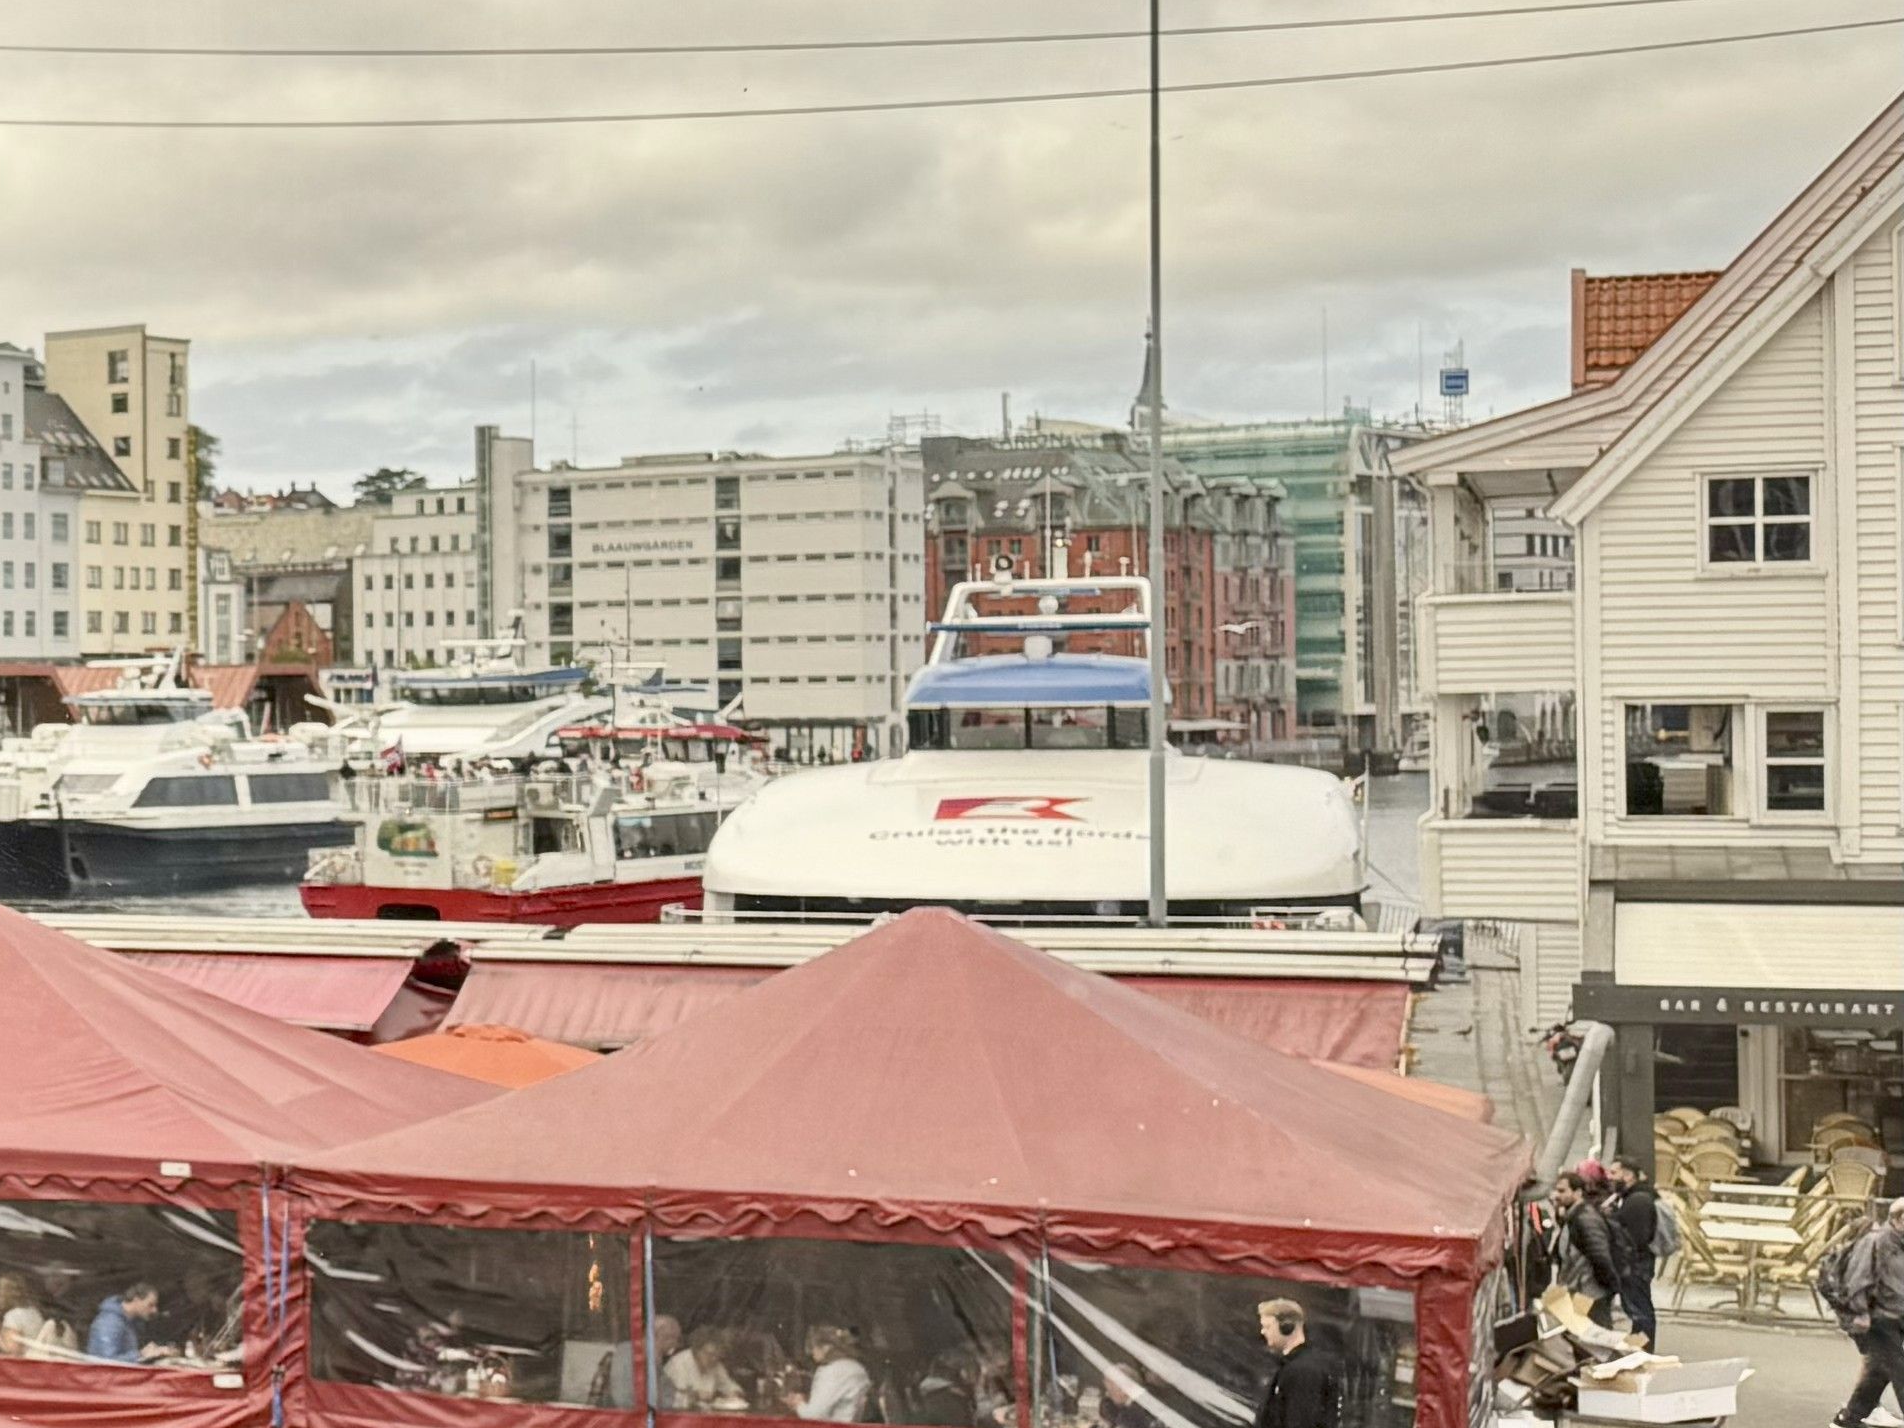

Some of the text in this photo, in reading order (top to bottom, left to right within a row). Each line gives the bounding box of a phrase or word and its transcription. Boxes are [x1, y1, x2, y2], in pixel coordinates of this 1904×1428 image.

[1660, 998, 1895, 1015] BAR & RESTAURANT
